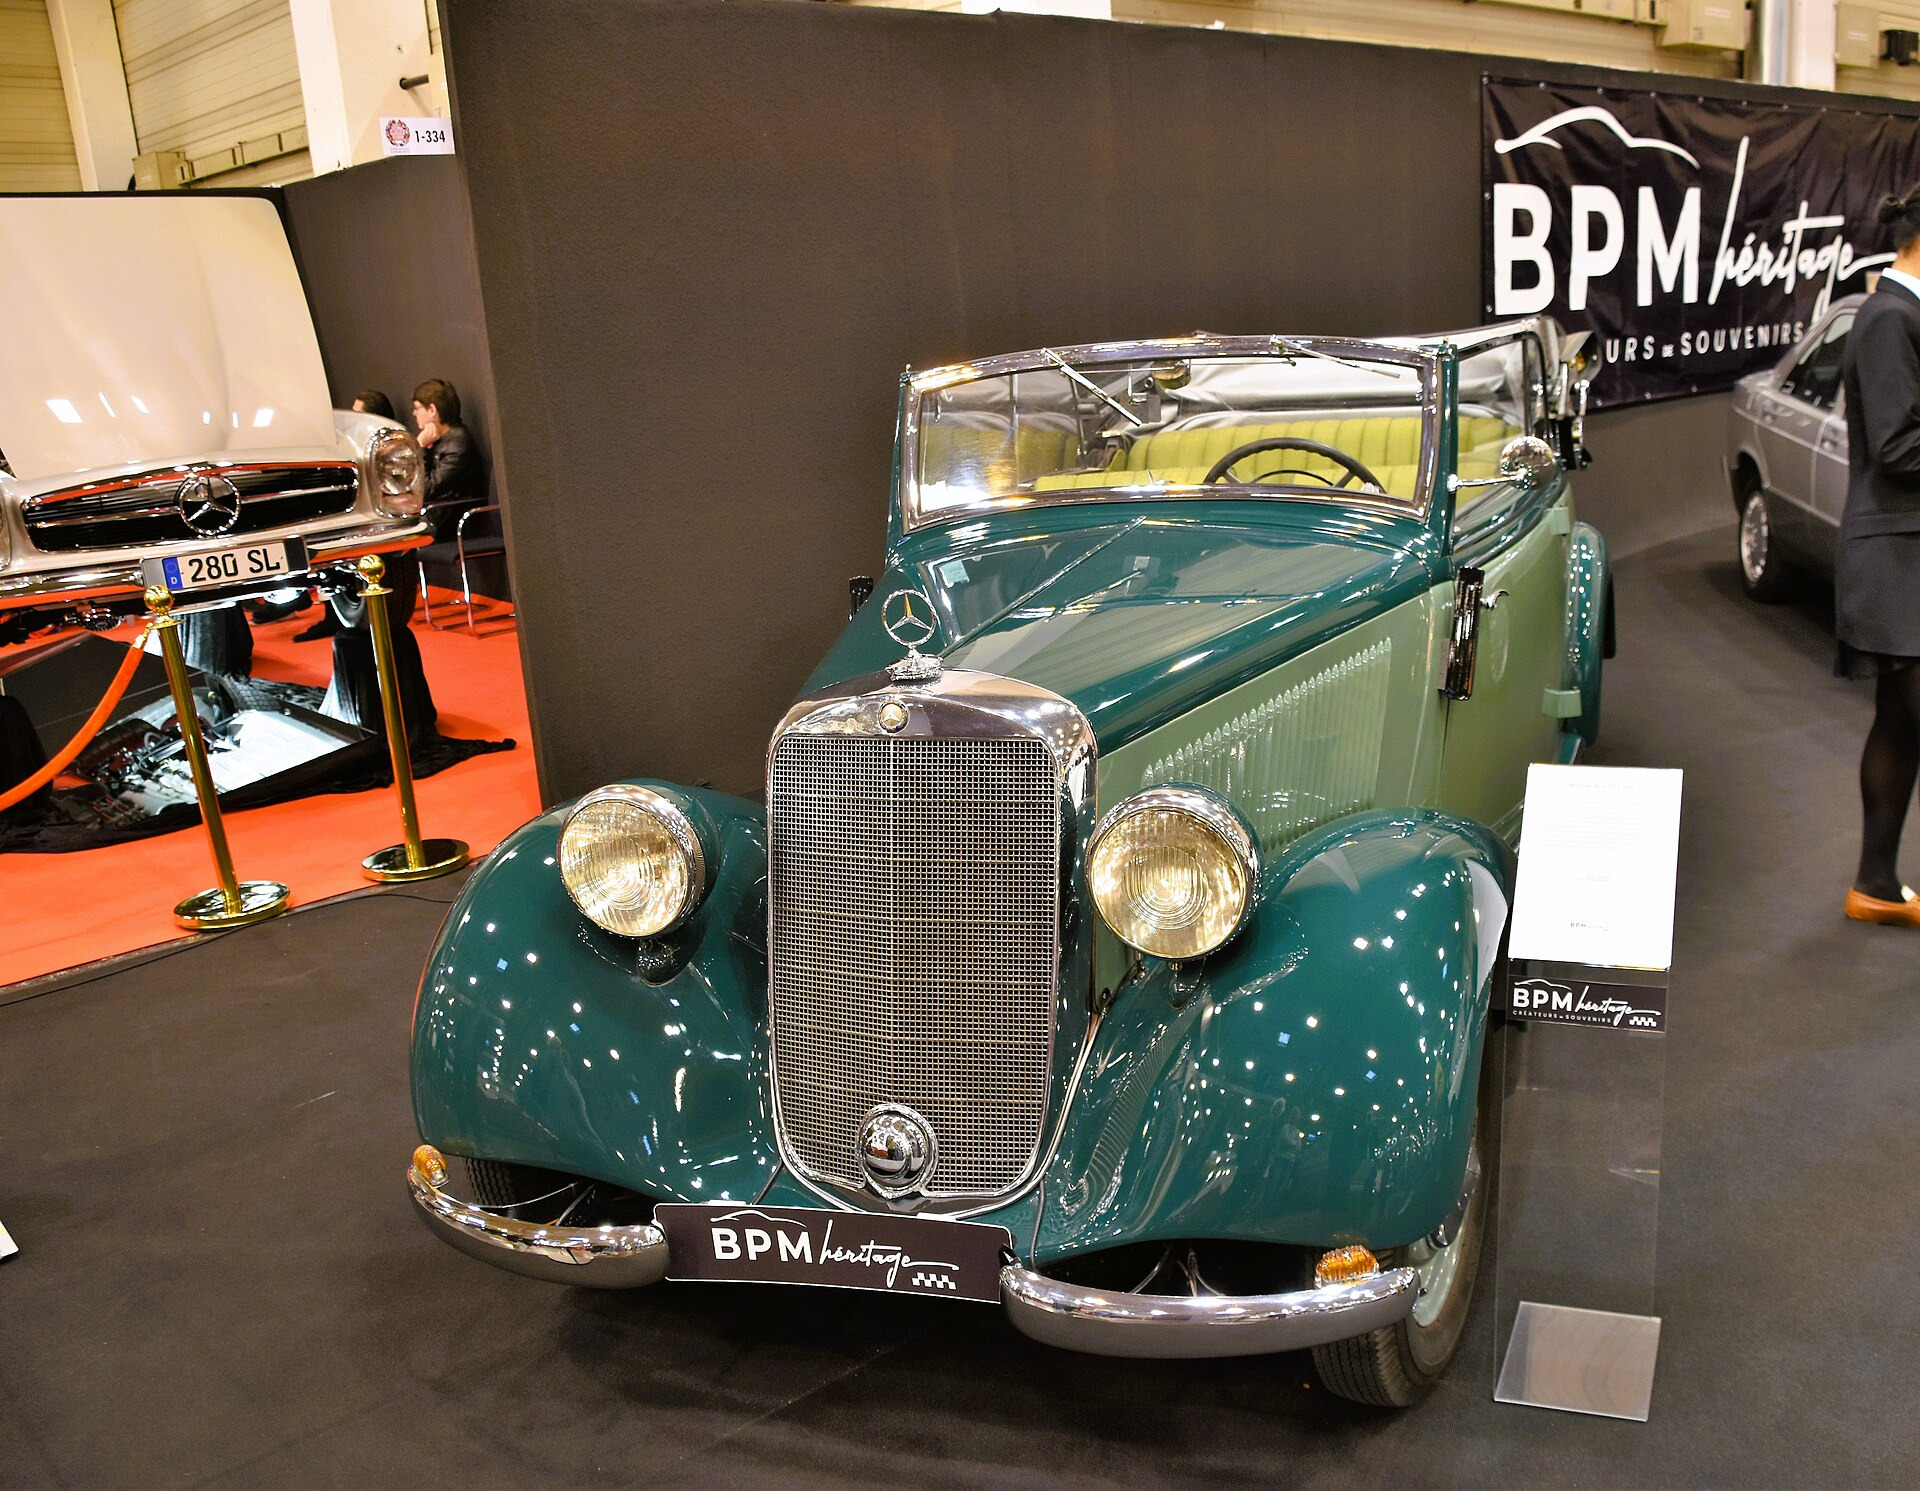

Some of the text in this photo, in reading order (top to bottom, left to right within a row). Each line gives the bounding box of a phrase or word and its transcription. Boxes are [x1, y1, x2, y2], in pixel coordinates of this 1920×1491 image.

[415, 130, 446, 143] 1-334
[1493, 135, 1898, 325] BPM héritage
[1680, 321, 1804, 357] SOUVENIRS
[170, 548, 281, 585] D 280 SL
[1513, 988, 1573, 1012] BPM
[1565, 1014, 1612, 1024] SOUVENIRS
[710, 1219, 960, 1289] BPM héritage
